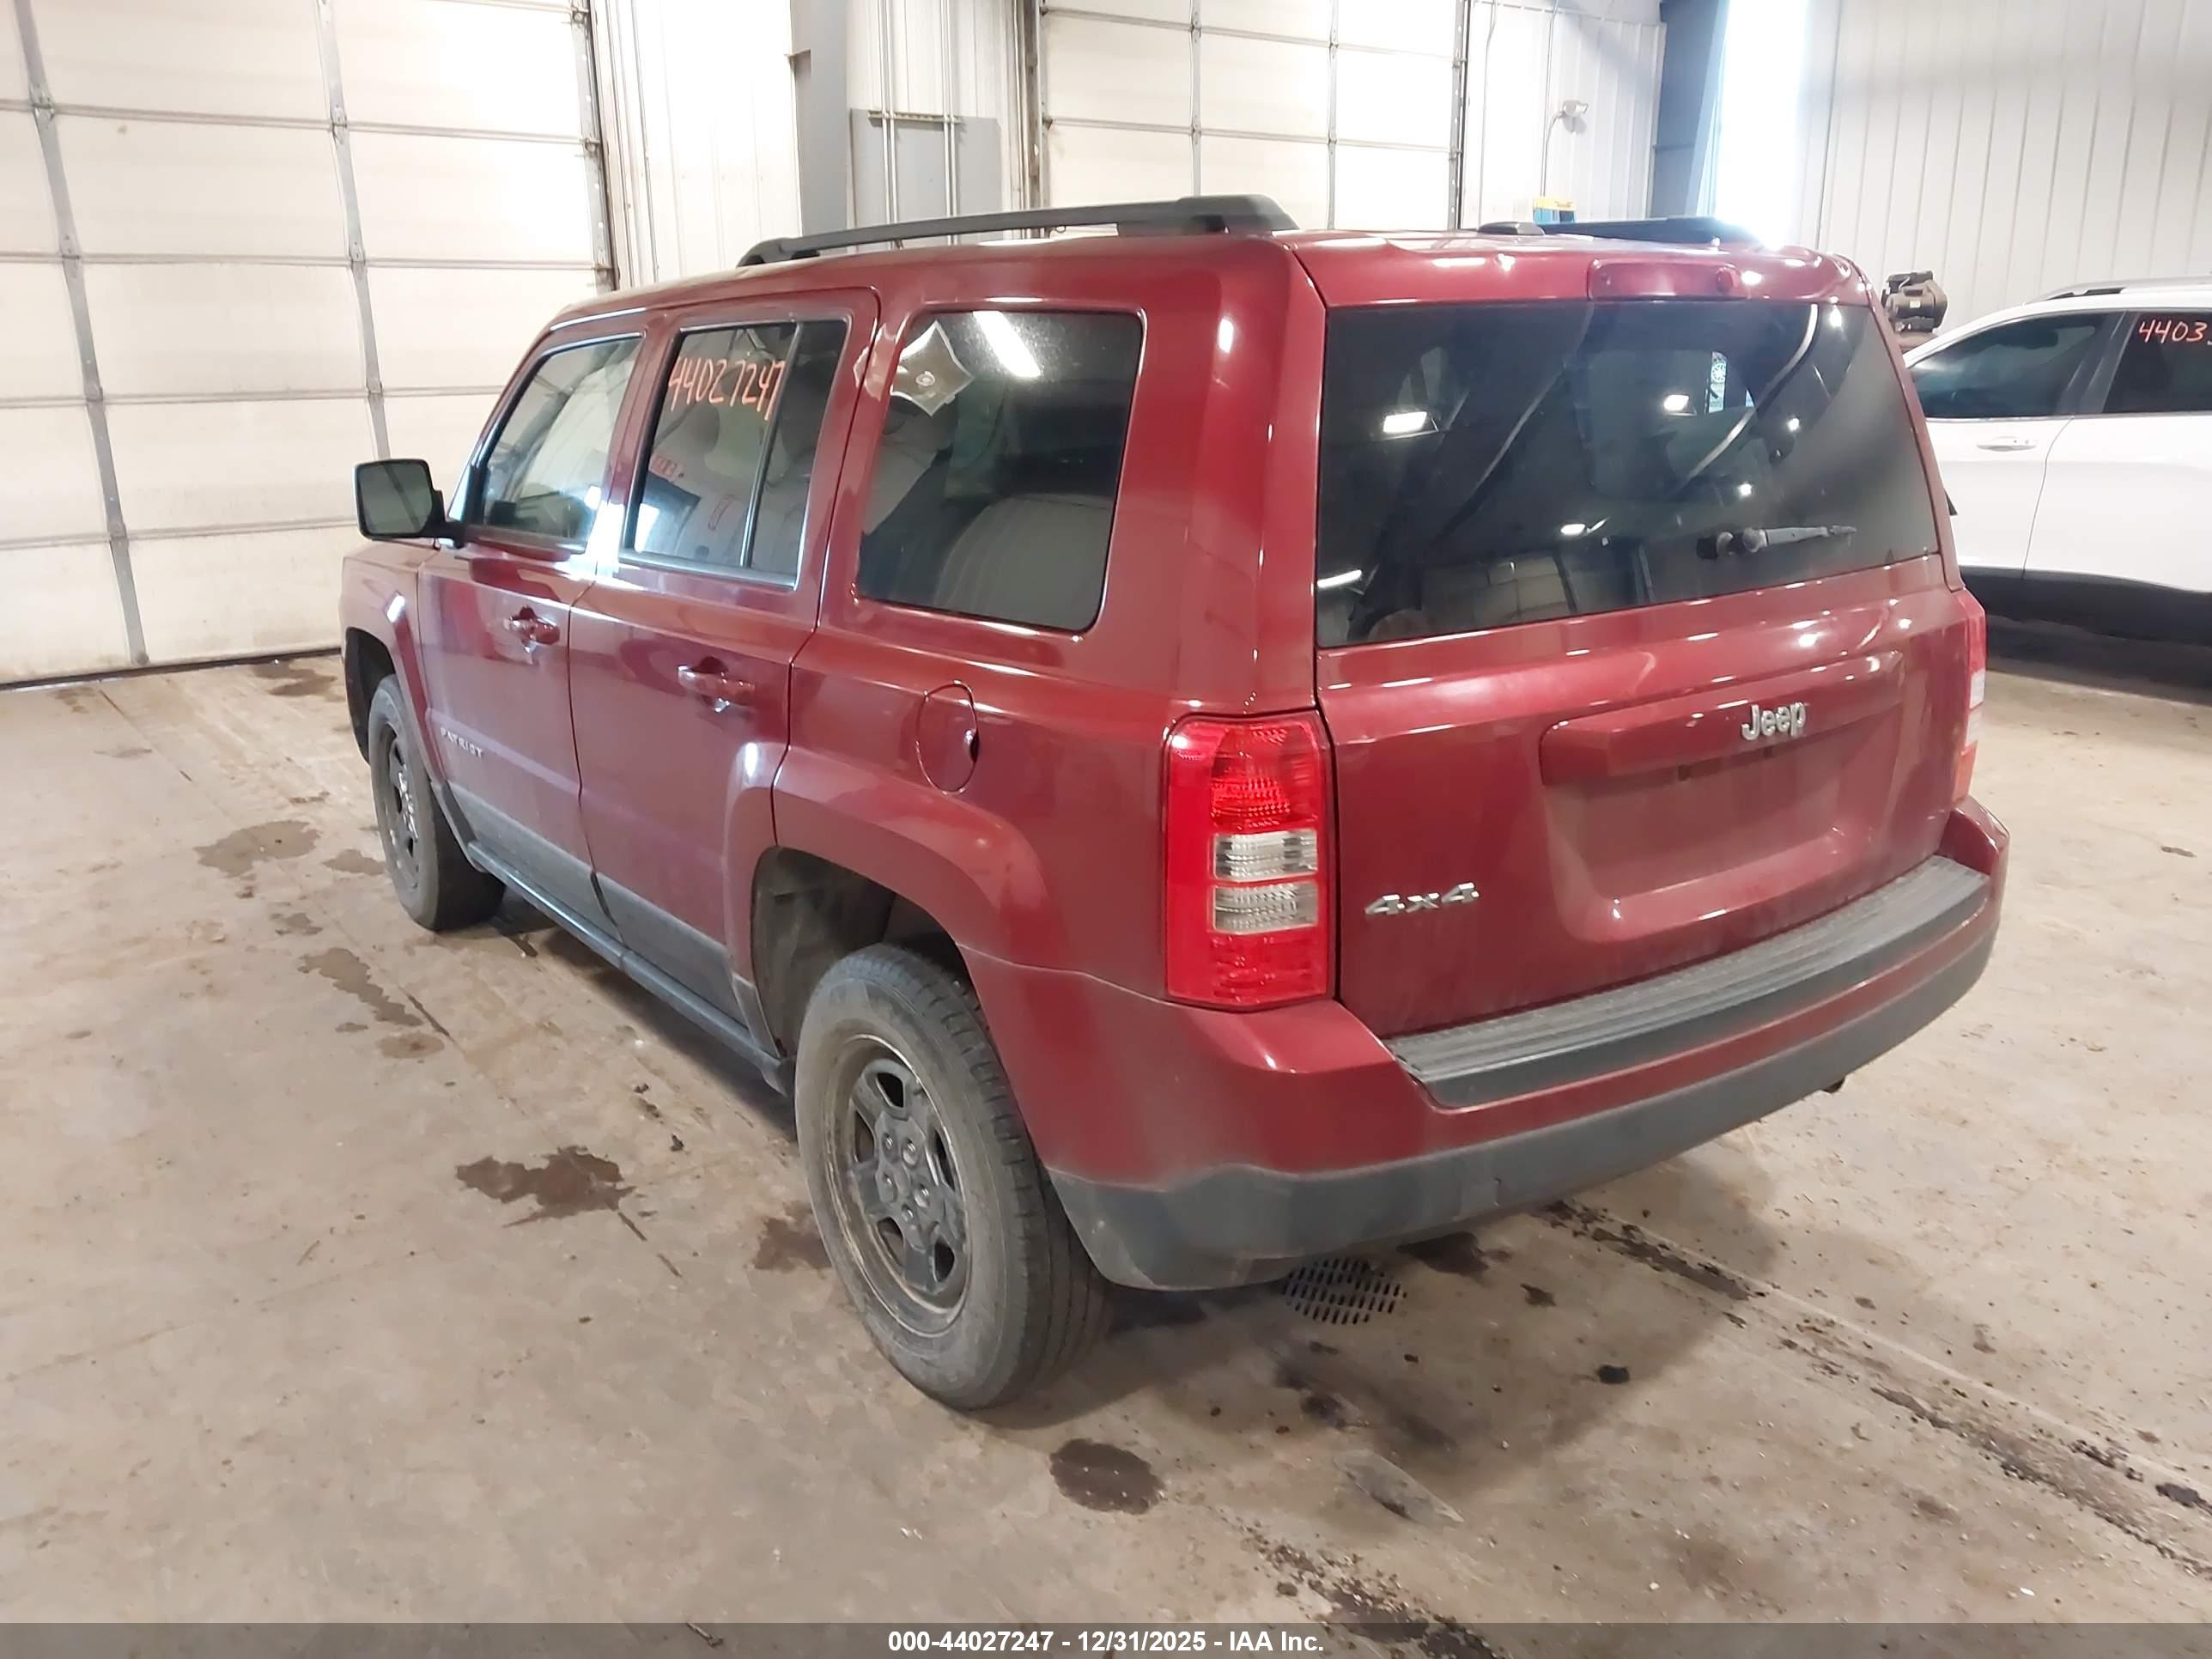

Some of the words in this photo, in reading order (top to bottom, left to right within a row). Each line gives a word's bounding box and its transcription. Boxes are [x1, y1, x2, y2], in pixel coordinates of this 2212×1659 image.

[2138, 319, 2212, 344] 4403
[667, 356, 786, 421] 44027247
[1741, 701, 1808, 740] Jeep
[1363, 881, 1480, 916] 4x4
